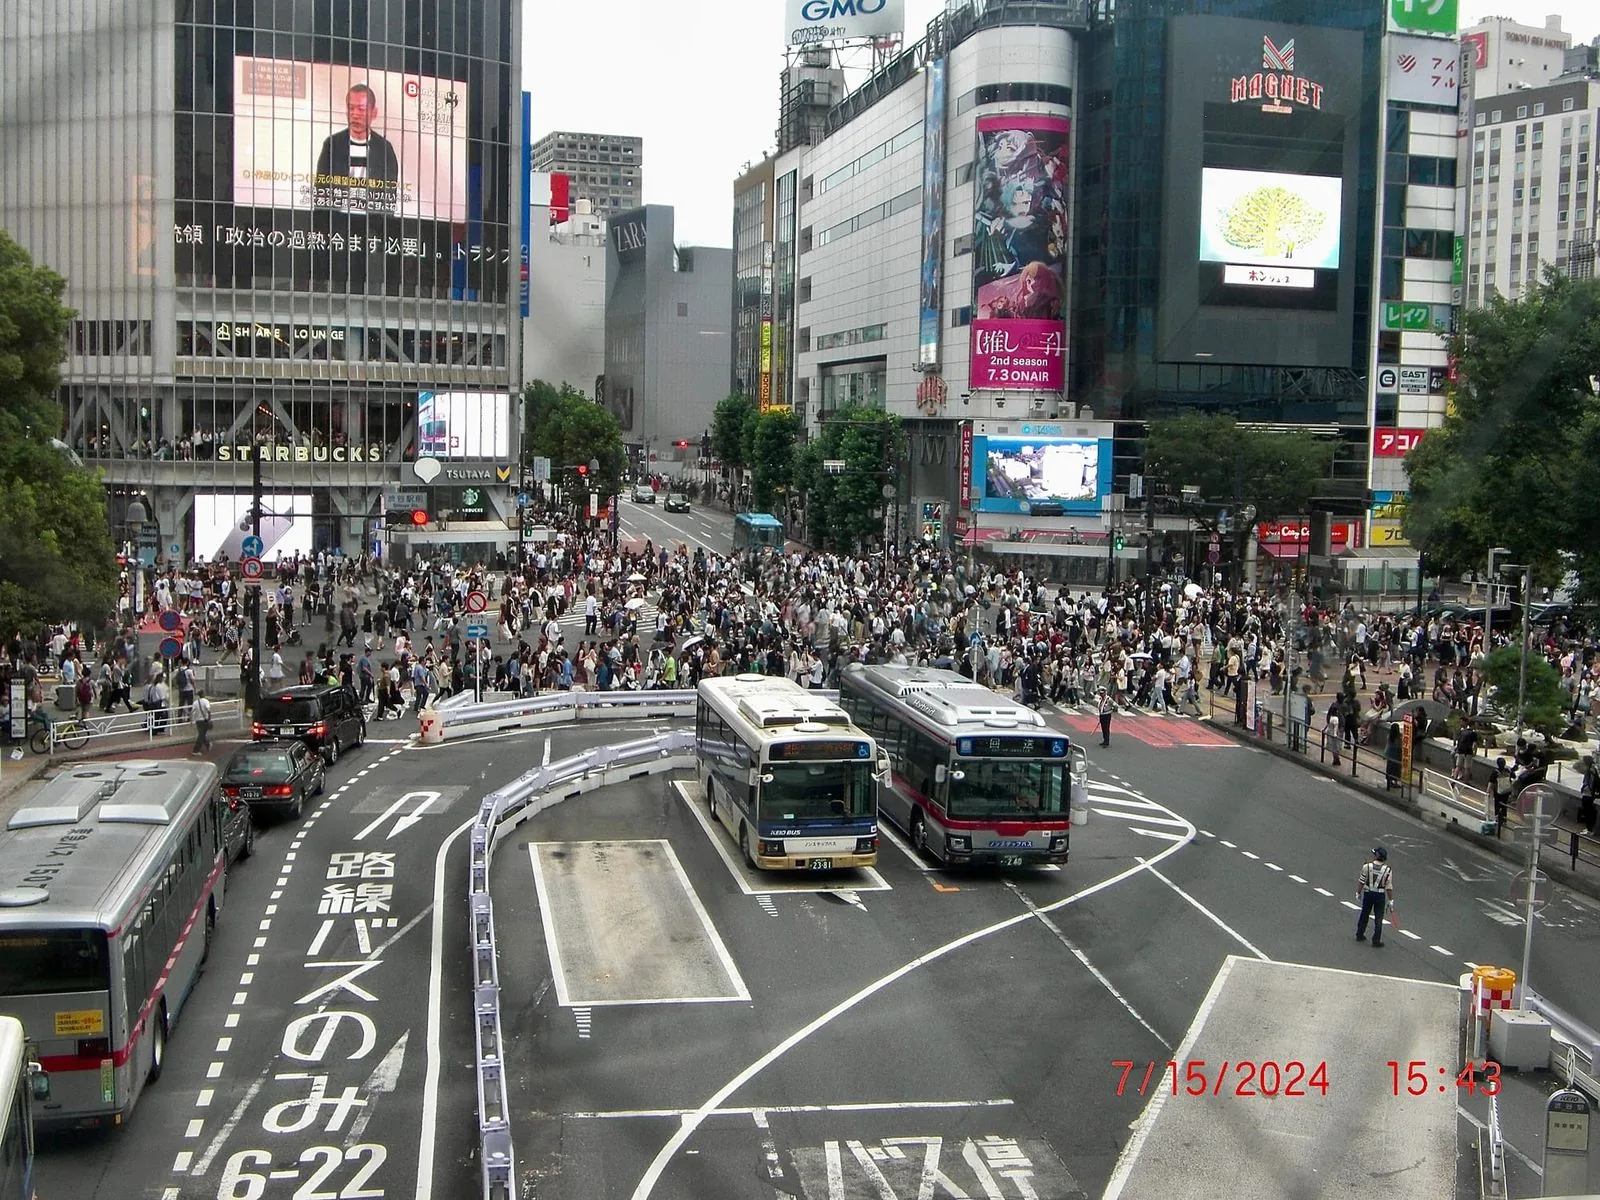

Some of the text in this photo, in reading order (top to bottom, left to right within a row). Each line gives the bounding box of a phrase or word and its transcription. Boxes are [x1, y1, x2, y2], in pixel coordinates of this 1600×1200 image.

[801, 0, 888, 20] GMO
[1231, 72, 1324, 111] MAGNET
[613, 219, 648, 252] ZARA
[1388, 307, 1427, 323] レイク
[235, 327, 344, 341] SHARE LOUNGE
[991, 356, 1048, 367] 2nd season
[988, 369, 1049, 382] 7.3 ONAIR
[218, 445, 380, 462] STARBUCKS
[446, 469, 491, 479] TSUTAYA
[912, 698, 936, 716] Hybrid
[262, 851, 398, 1134] 路線バスのみ
[217, 1143, 388, 1200] 6-22
